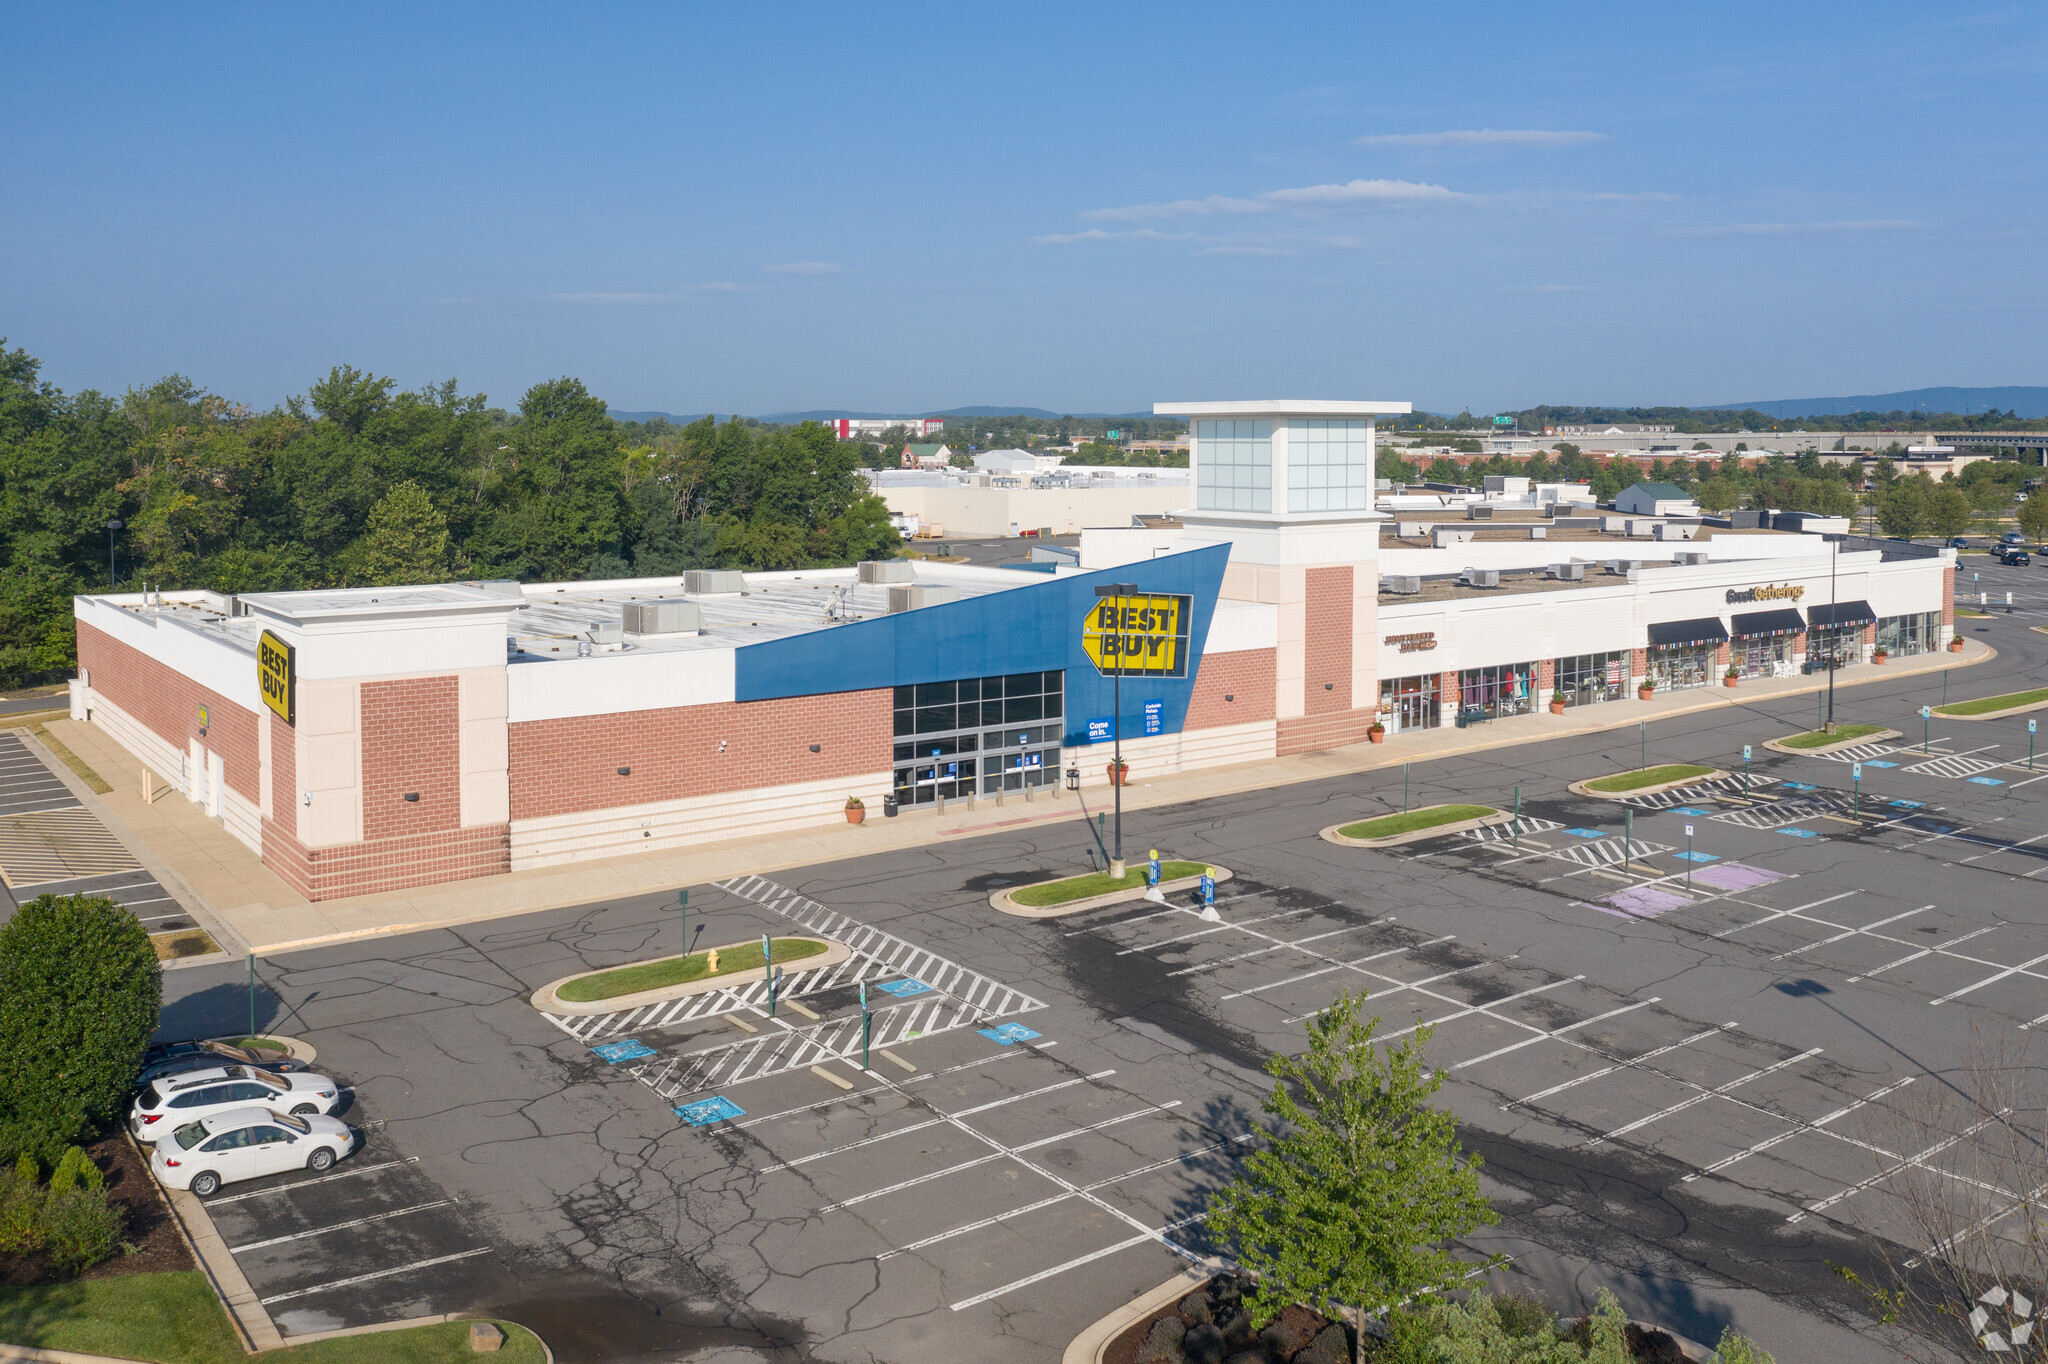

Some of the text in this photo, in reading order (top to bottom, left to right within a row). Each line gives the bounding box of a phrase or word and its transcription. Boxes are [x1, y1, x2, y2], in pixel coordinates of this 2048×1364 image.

[1754, 582, 1804, 602] Gatherings
[1098, 606, 1175, 632] BEST
[1100, 634, 1166, 657] BUY
[261, 641, 287, 680] BEST
[262, 668, 285, 704] BUY
